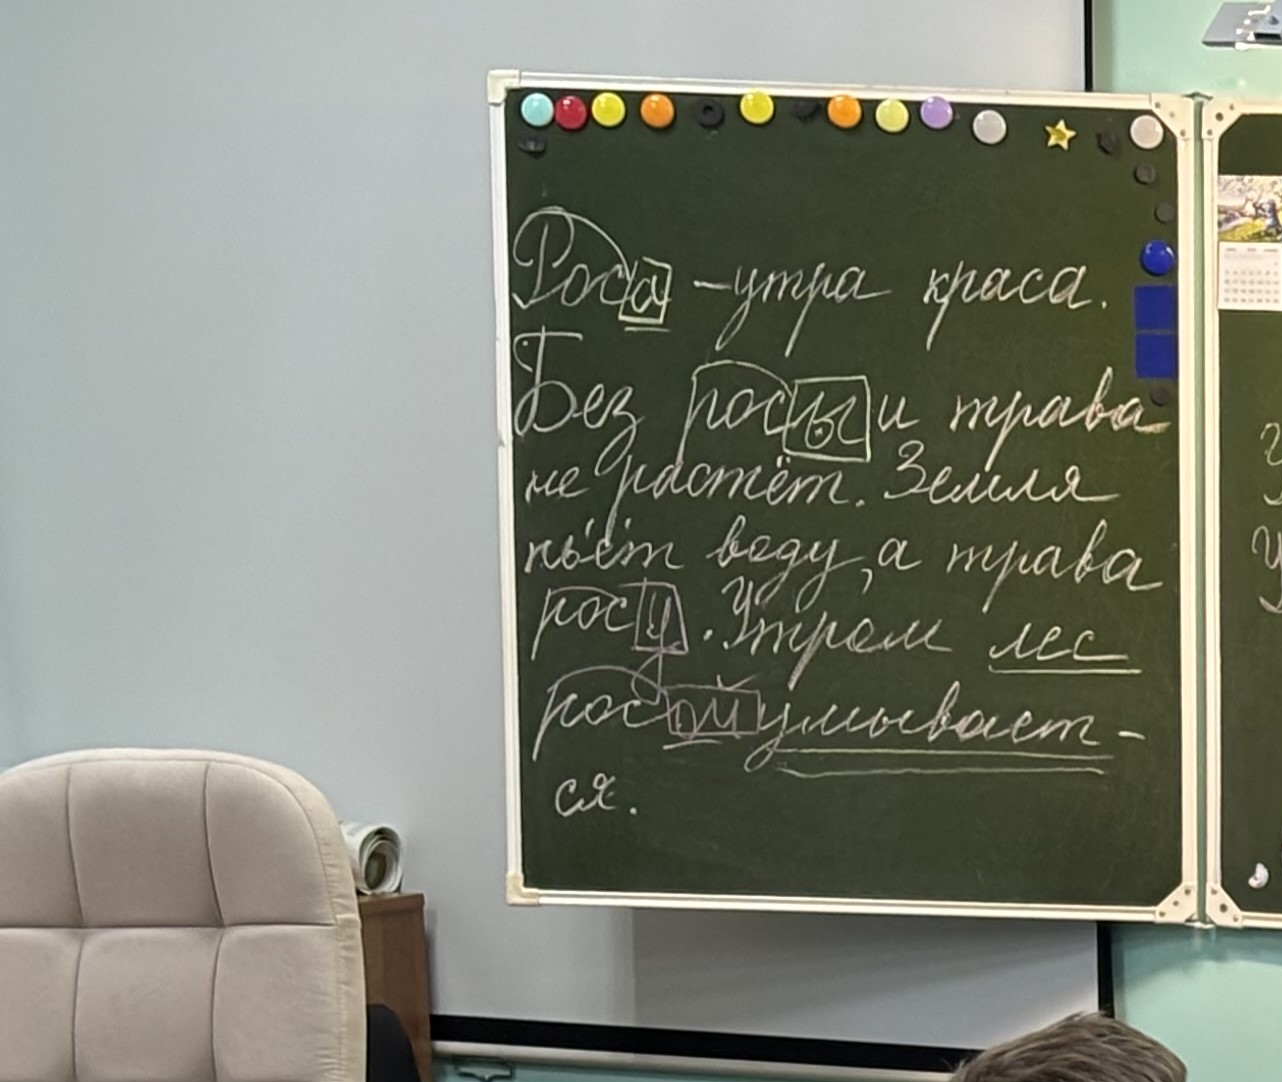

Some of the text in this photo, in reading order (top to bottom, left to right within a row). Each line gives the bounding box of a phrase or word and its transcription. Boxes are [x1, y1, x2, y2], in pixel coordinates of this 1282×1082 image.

[512, 206, 672, 326] Роса
[513, 326, 1171, 476] Без росы и трава
[524, 464, 589, 502] не
[884, 438, 1120, 504] Земля
[877, 536, 923, 572] а
[945, 518, 1164, 614] трава
[721, 574, 953, 691] Утром
[988, 622, 1129, 662] лес
